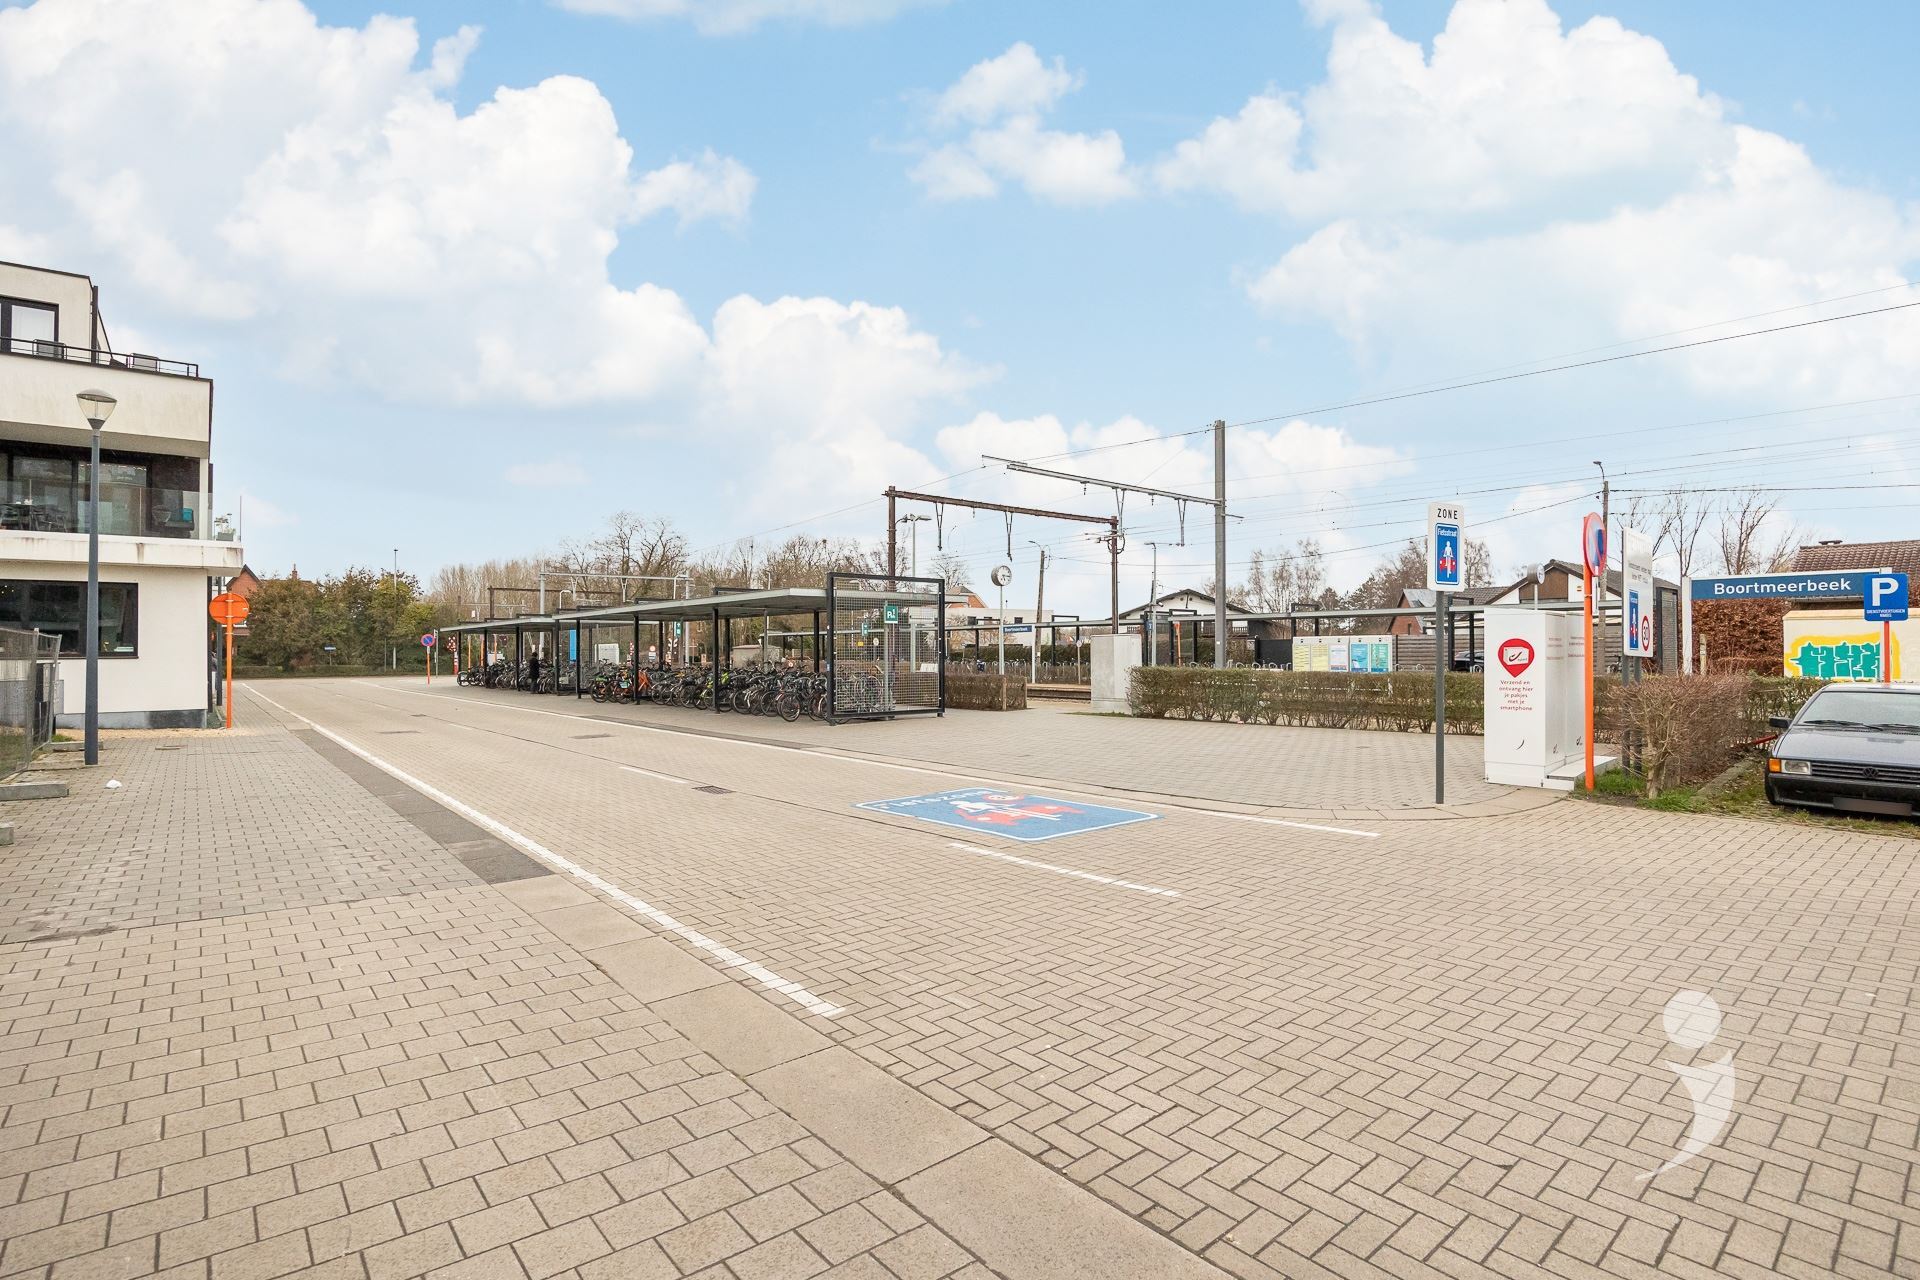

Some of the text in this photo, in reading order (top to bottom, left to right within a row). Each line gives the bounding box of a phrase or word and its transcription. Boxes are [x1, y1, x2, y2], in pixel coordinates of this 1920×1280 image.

[1437, 508, 1458, 520] ZONE
[1714, 578, 1851, 595] Boortmeerbeek
[1871, 577, 1899, 607] P
